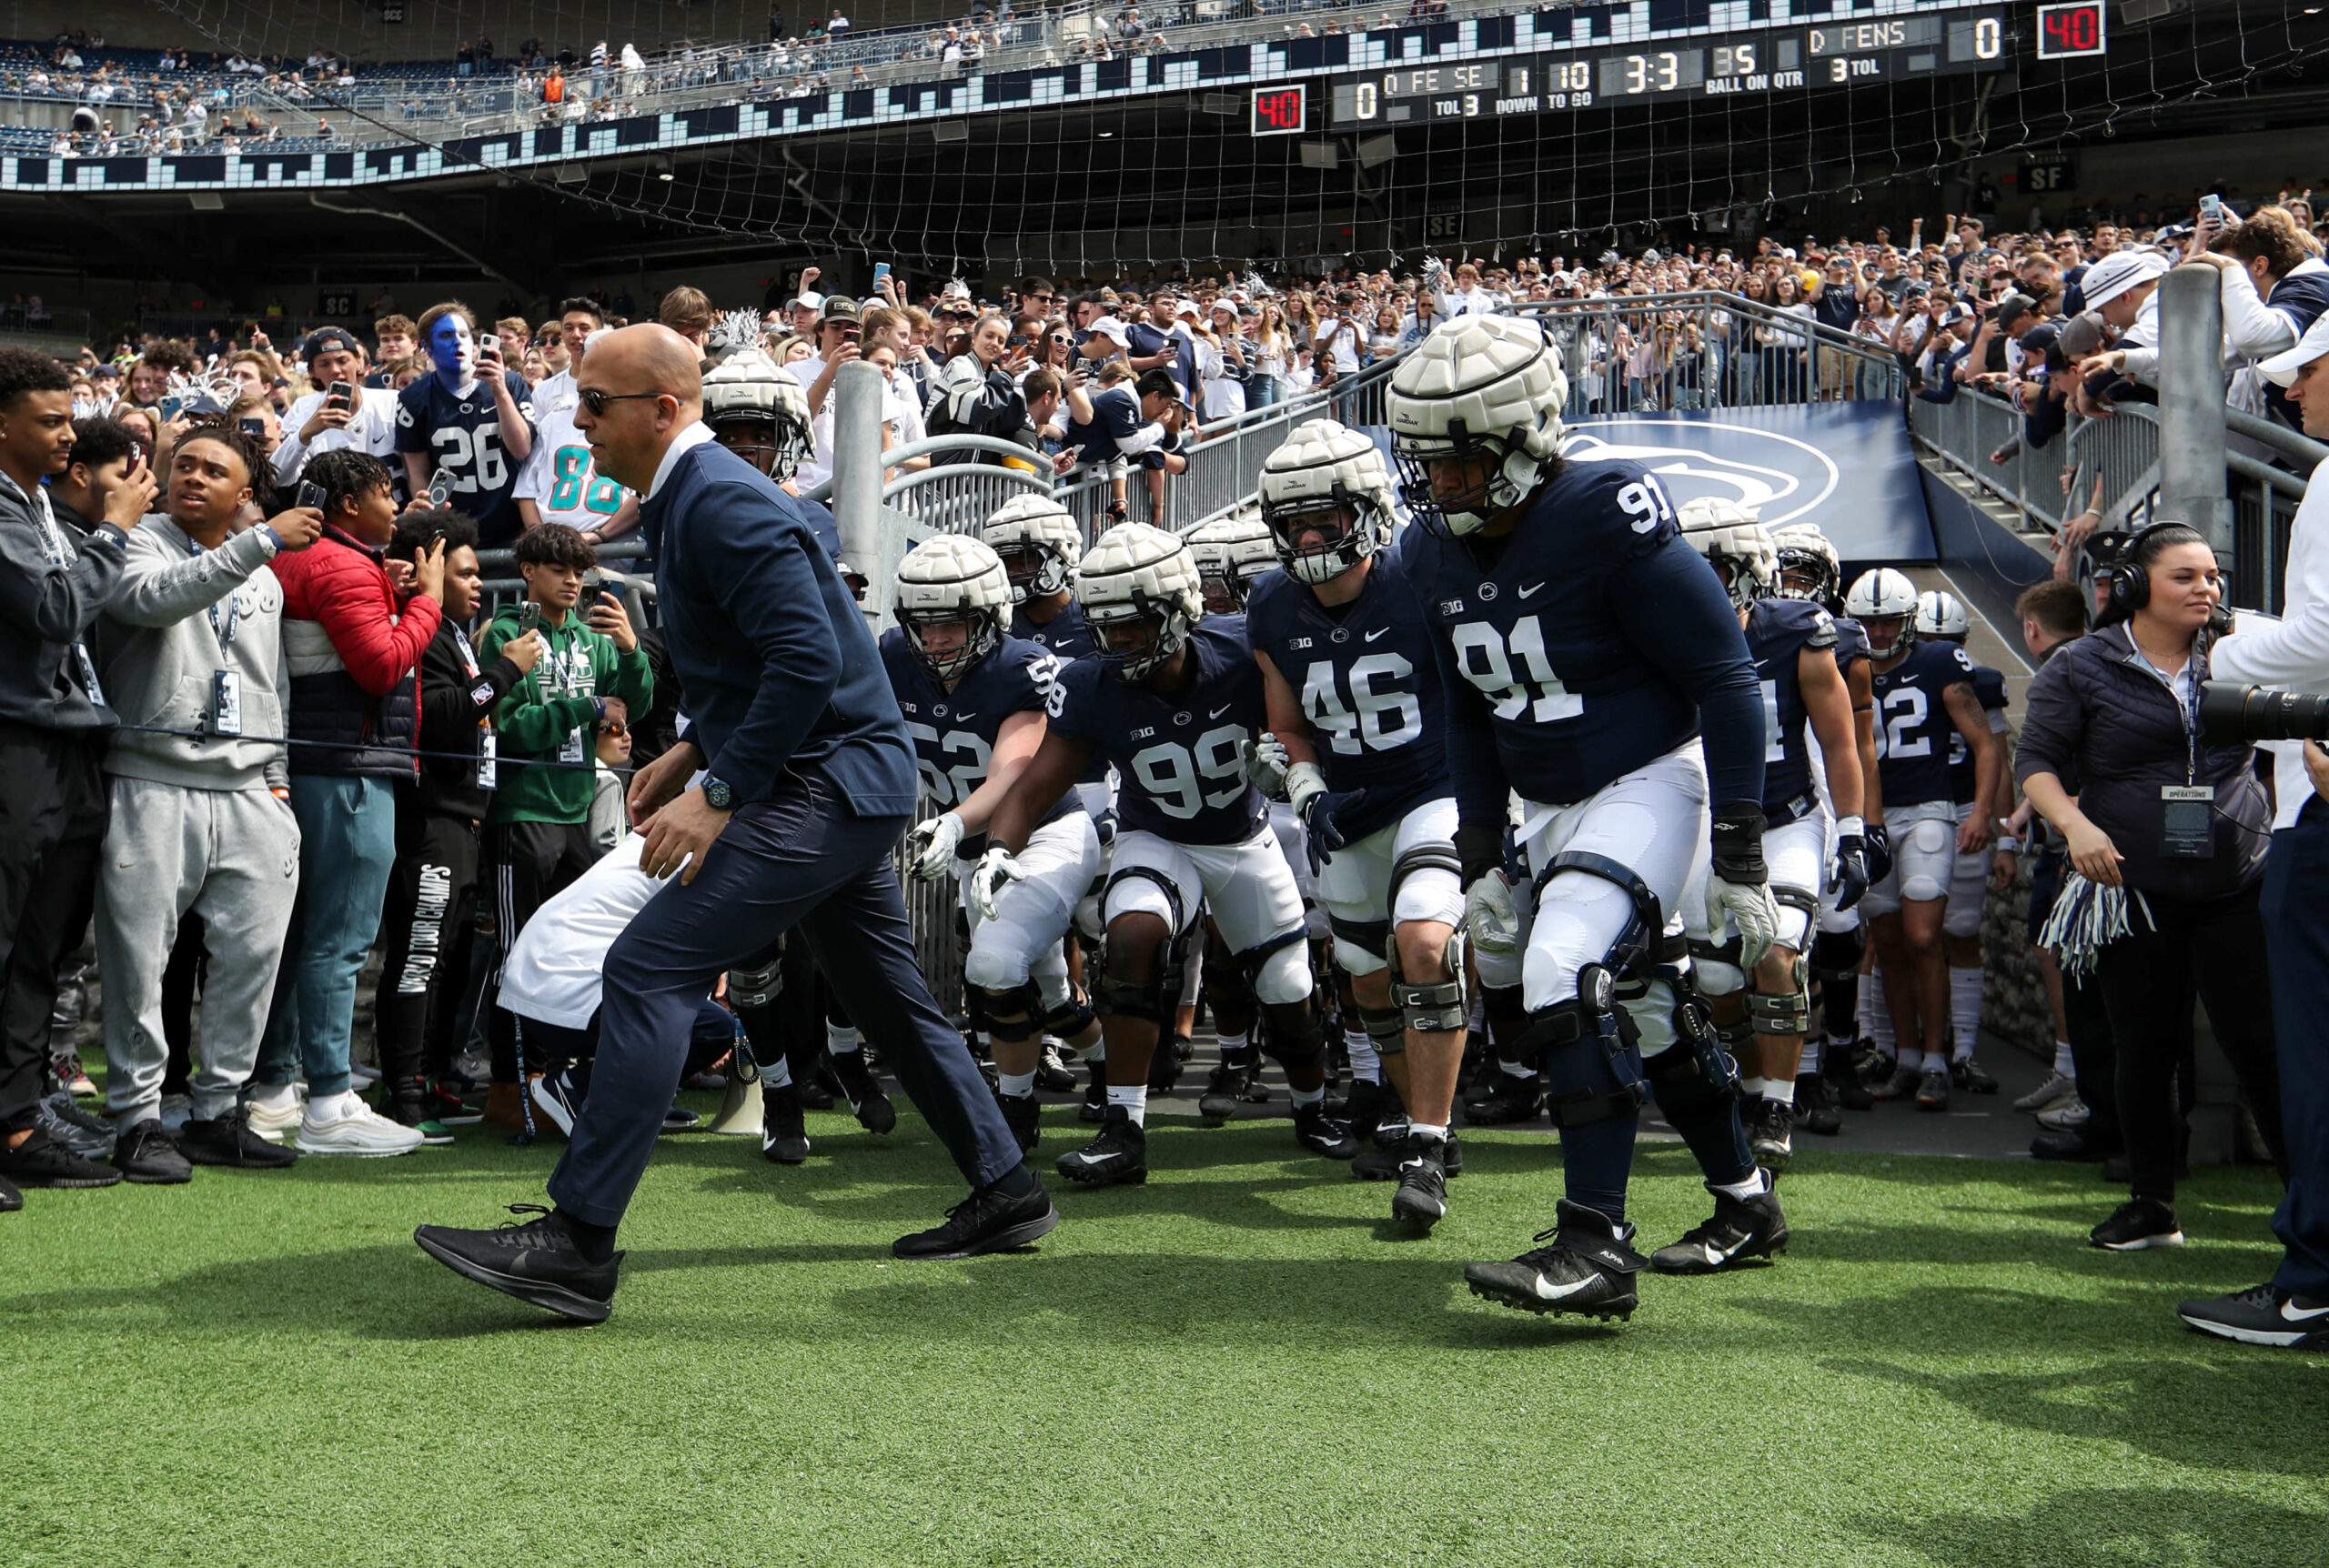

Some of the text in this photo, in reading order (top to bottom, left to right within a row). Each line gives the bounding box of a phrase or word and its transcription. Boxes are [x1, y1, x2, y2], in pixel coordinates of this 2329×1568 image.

[1841, 21, 1906, 49] FENS
[1975, 18, 2001, 59] 0
[2046, 8, 2097, 49] 40
[1412, 69, 1439, 93] FE
[1454, 65, 1483, 89] SE
[1560, 61, 1589, 90] 10
[1627, 52, 1678, 94] 3:3
[1773, 71, 1803, 88] QTR
[1831, 57, 1848, 82] 3
[1850, 58, 1880, 75] TOL
[1520, 69, 1528, 93] 1
[1706, 75, 1768, 95] BALL ON
[1257, 92, 1299, 127] 40
[1356, 83, 1376, 119] 0
[1436, 100, 1460, 116] TOL
[1465, 95, 1479, 116] 3
[1497, 96, 1538, 115] DOWN
[1548, 92, 1592, 109] TO GO
[2031, 167, 2062, 190] SF
[1430, 216, 1457, 236] SE
[326, 297, 349, 315] SC
[431, 422, 509, 493] 26
[1617, 473, 1671, 535] 91
[1452, 615, 1584, 723] 91
[1301, 652, 1423, 755] 46
[903, 720, 993, 806] 52
[1131, 723, 1249, 819] 99
[398, 864, 451, 992] WORLD TOUR CHAMPS
[1600, 1251, 1625, 1266] ALPHA
